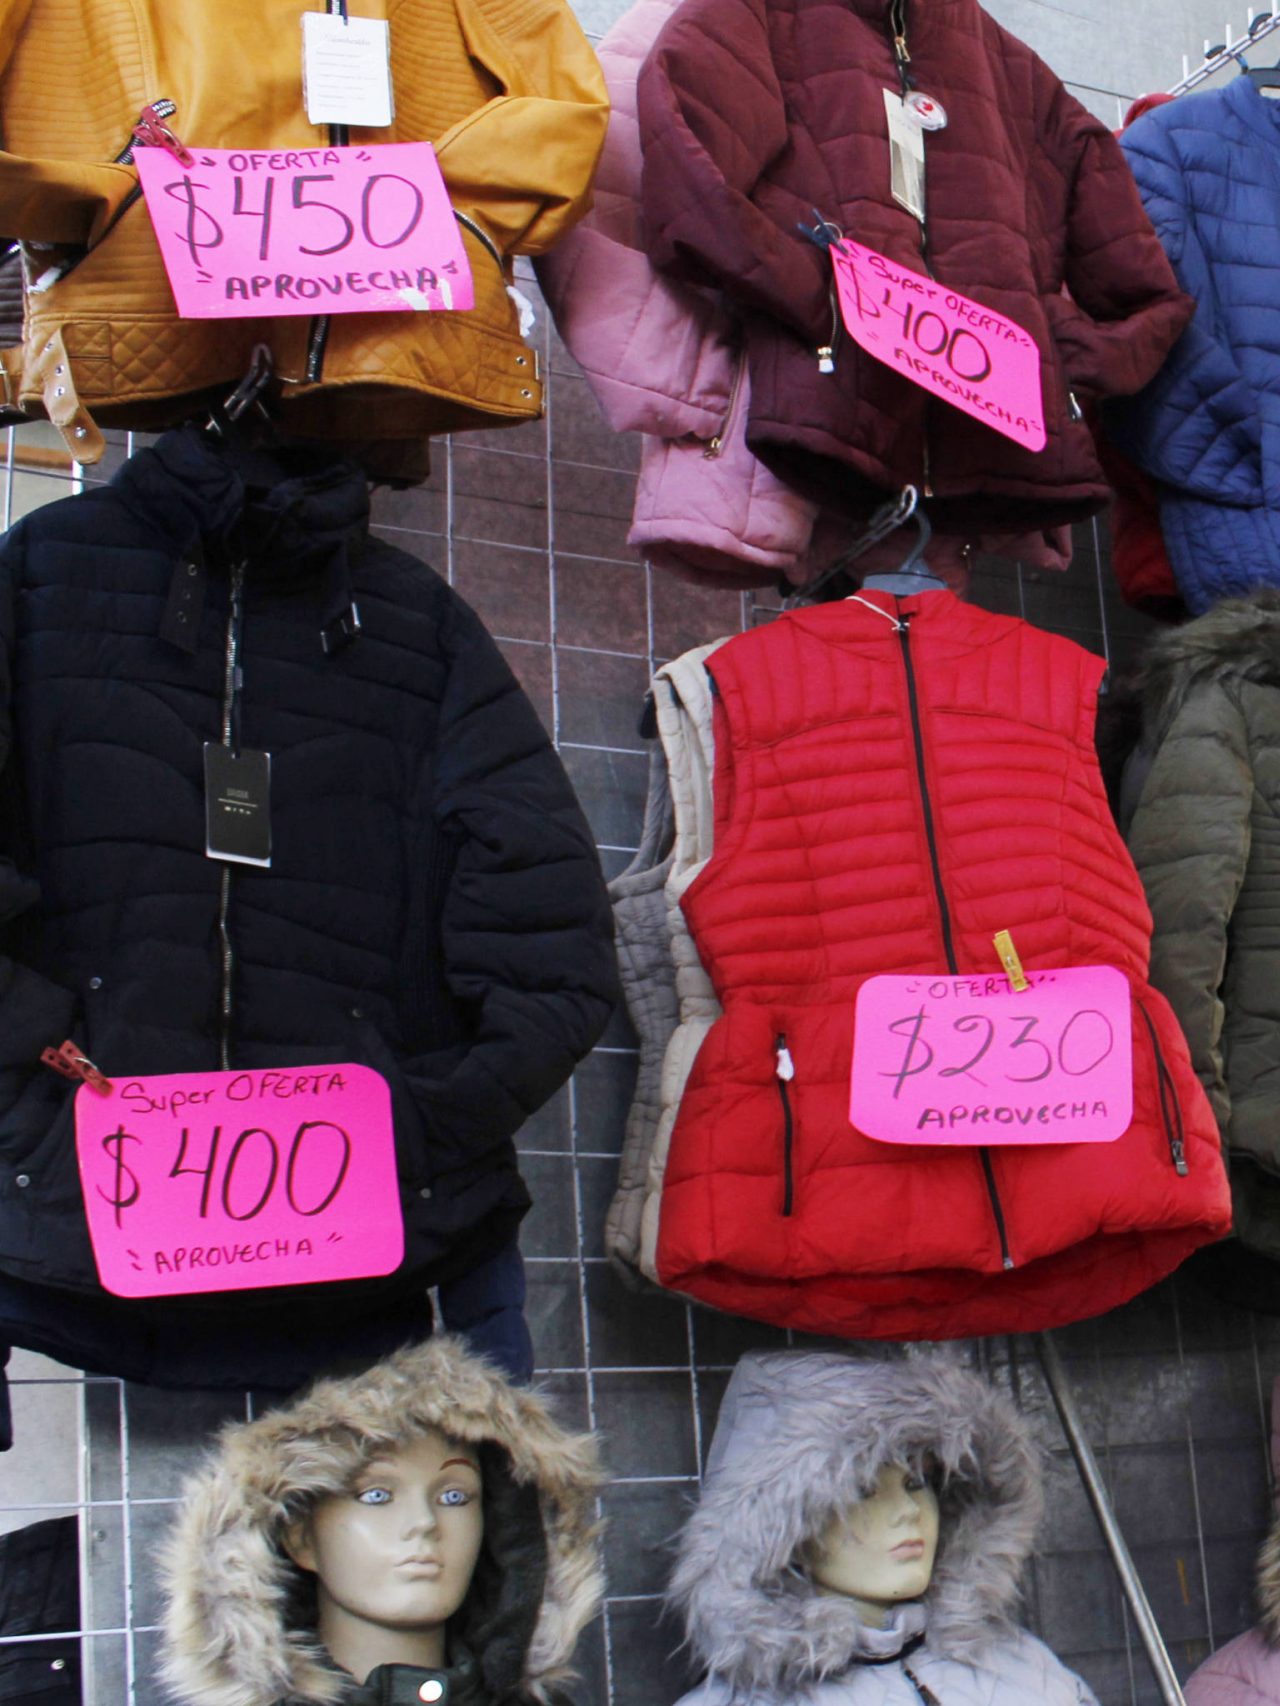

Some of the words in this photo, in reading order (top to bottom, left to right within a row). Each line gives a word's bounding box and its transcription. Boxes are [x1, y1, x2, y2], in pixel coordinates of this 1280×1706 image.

[163, 173, 424, 267] $450
[836, 257, 992, 383] $400
[120, 1082, 216, 1118] Super
[225, 1072, 347, 1101] OFERTA
[877, 1003, 1113, 1100] $230
[96, 1120, 351, 1229] $400
